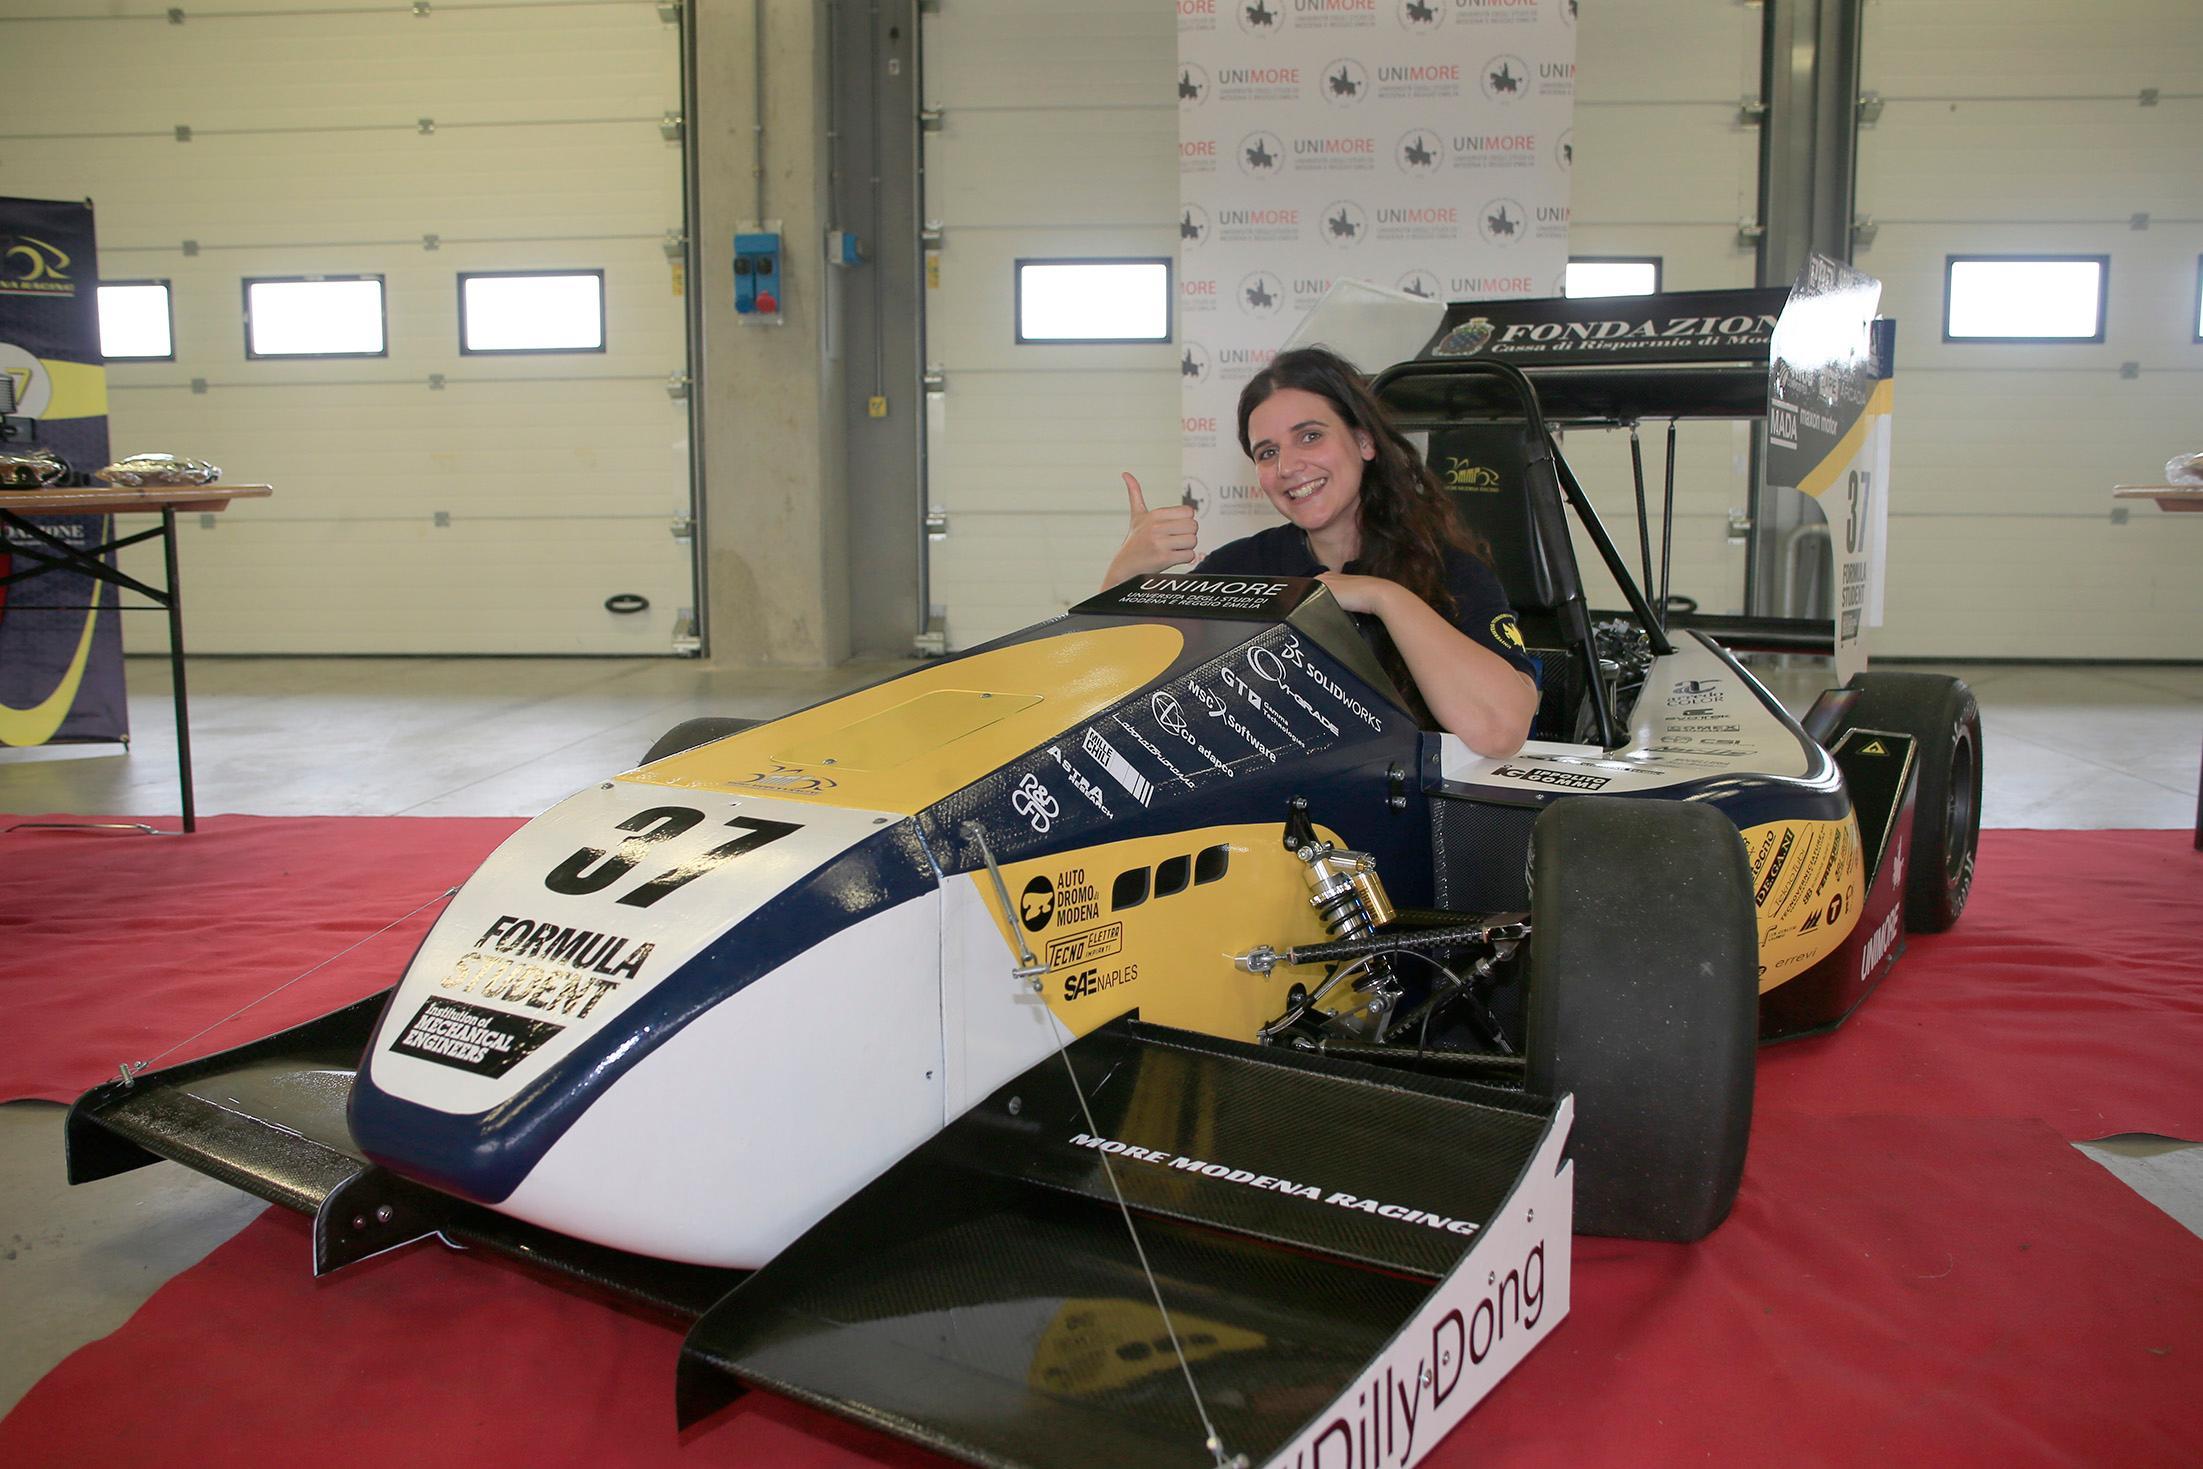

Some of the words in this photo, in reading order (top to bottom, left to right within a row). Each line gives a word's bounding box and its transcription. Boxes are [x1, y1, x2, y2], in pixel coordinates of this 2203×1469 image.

[1295, 0, 1376, 12] UNIMORE
[1219, 68, 1300, 84] UNIMORE
[1378, 65, 1459, 81] UNIMORE
[1294, 138, 1375, 154] UNIMORE
[1453, 135, 1535, 151] UNIMORE
[1219, 209, 1299, 225] UNIMORE
[1376, 207, 1457, 224] UNIMORE
[1451, 277, 1532, 293] UNIMORE
[1499, 315, 1777, 342] FONDAZION
[1491, 343, 1546, 353] Cassa
[1552, 341, 1573, 351] di
[1579, 338, 1691, 352] Risparmio
[1698, 336, 1720, 346] di
[1770, 407, 1798, 441] MADA
[1845, 469, 1871, 554] 37
[1140, 578, 1288, 596] UNIMORE
[1119, 597, 1167, 605] MODENA
[1221, 667, 1248, 696] GT
[1306, 662, 1383, 733] SOLIDWORKS
[1187, 680, 1214, 709] MSC
[1227, 714, 1277, 763] Software
[1263, 701, 1289, 727] Gamma
[1262, 708, 1306, 748] Technologies
[1086, 740, 1112, 767] CHILI
[1088, 731, 1113, 757] MILLE
[1180, 728, 1196, 746] CD
[1198, 744, 1235, 779] adapco
[1527, 775, 1601, 790] GOMME
[1532, 769, 1607, 785] IPPOLITO
[544, 805, 806, 909] 37
[1057, 868, 1085, 890] AUTO
[1057, 885, 1094, 906] DROMO
[1056, 903, 1100, 928] MODENA
[473, 916, 656, 980] FORMULA
[1861, 901, 1900, 981] UNIMORE
[440, 953, 620, 1020] STUDENT
[1097, 964, 1138, 992] NAPLES
[425, 1001, 477, 1025] Institution
[479, 1017, 494, 1029] of
[402, 1030, 490, 1064] ENGINEERS
[413, 1015, 515, 1053] MECHANICAL
[1069, 1133, 1170, 1164] MORE
[1168, 1156, 1321, 1200] MODENA
[1325, 1192, 1480, 1236] RACING
[1284, 1239, 1544, 1468] DillyDong
